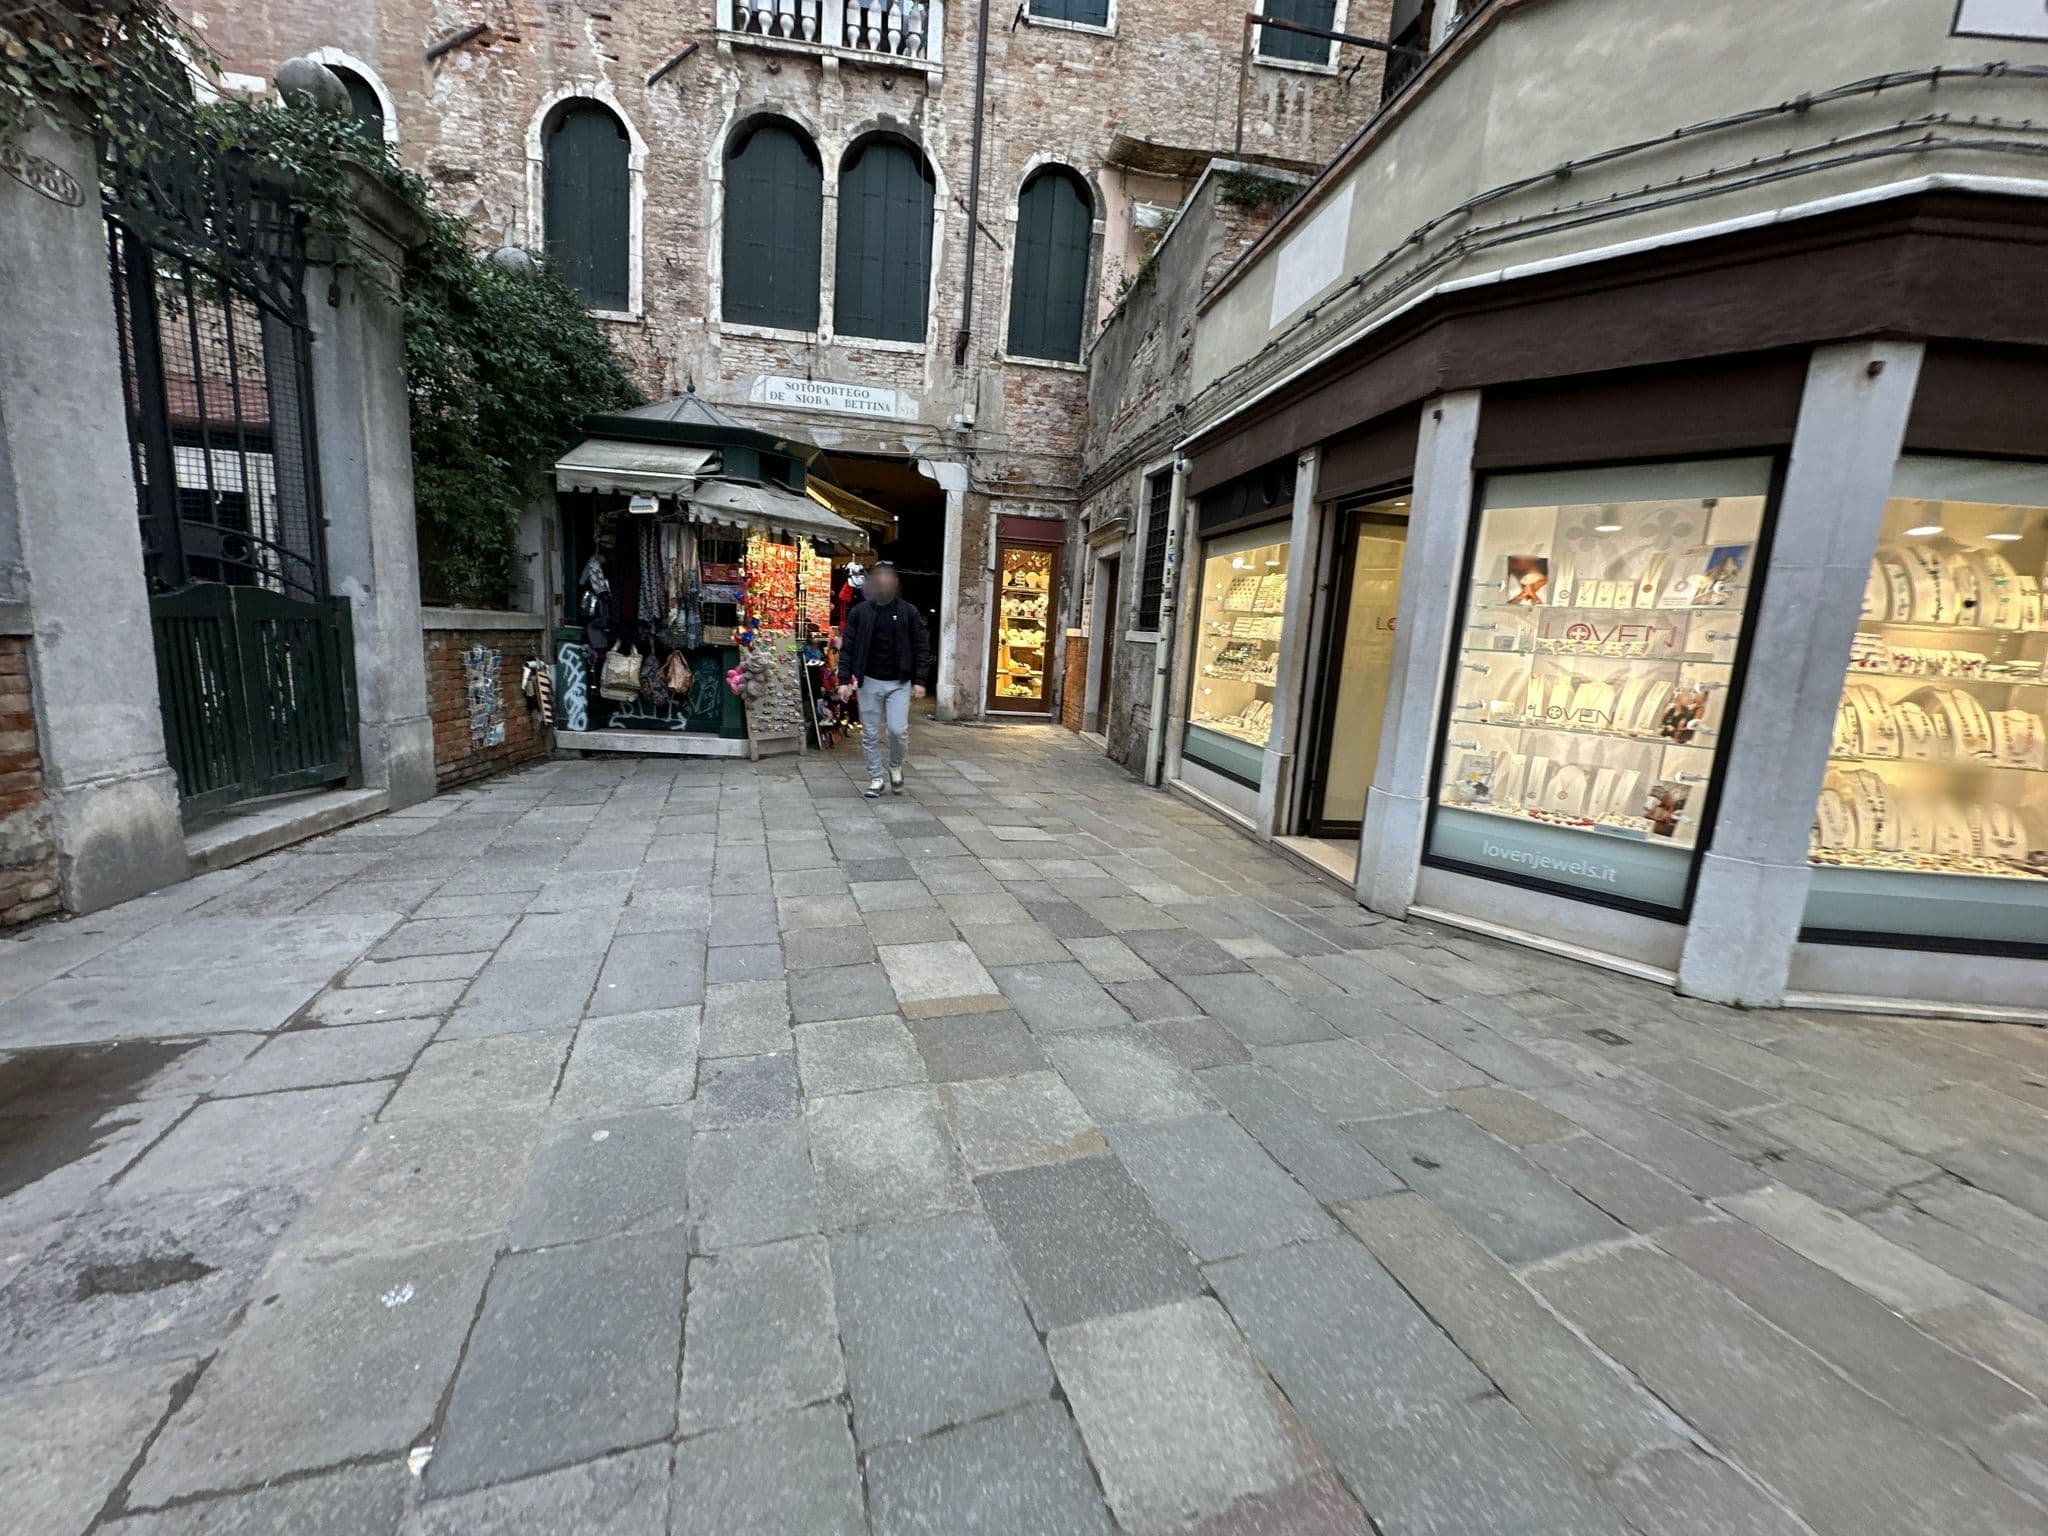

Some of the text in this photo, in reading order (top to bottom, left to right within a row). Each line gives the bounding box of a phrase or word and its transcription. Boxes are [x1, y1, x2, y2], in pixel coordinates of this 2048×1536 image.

[785, 381, 870, 399] SOTOPORTEGO
[770, 391, 891, 413] DE SIORA BETTINA
[1532, 704, 1616, 725] LOVEN
[1482, 840, 1617, 882] lovenjewels.it
